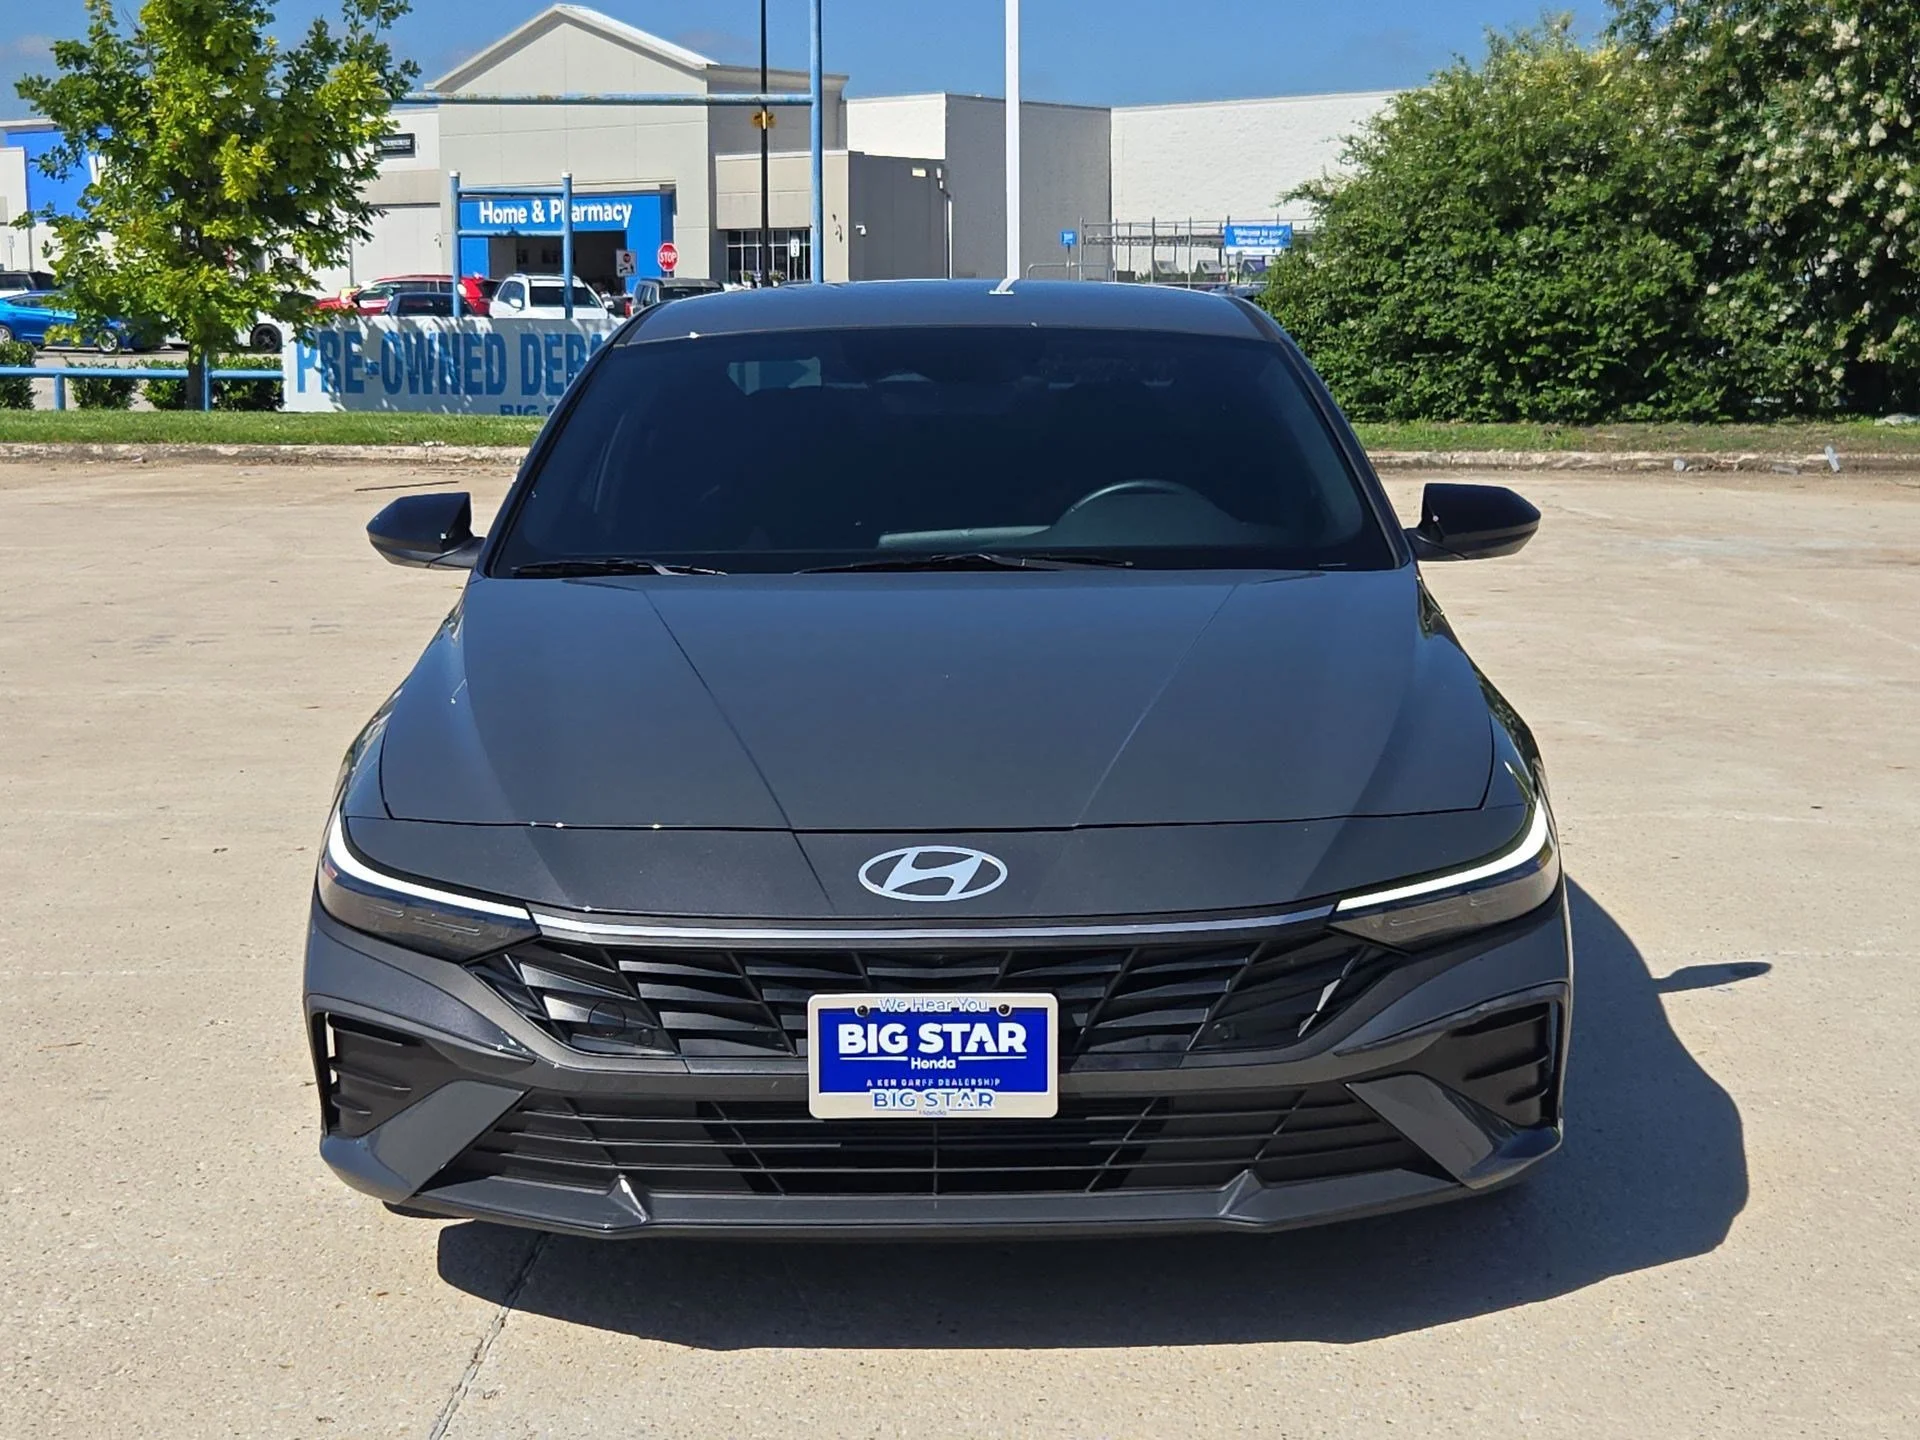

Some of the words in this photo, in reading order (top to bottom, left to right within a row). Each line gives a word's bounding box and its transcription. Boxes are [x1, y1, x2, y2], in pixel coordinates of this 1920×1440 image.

[479, 201, 527, 224] Home
[532, 199, 545, 223] &
[660, 251, 677, 263] STOP
[296, 330, 508, 396] PRE-OWNED
[880, 998, 906, 1011] We
[912, 997, 952, 1011] Hear
[957, 997, 988, 1011] You
[838, 1023, 908, 1054] BIG
[918, 1022, 1027, 1054] STAR
[911, 1057, 956, 1070] Honda
[866, 1079, 873, 1087] A
[877, 1079, 897, 1087] KEN
[901, 1078, 933, 1087] GARFF
[938, 1078, 1000, 1087] DEALERSHIP
[873, 1091, 916, 1107] BIG
[925, 1091, 994, 1107] STAR
